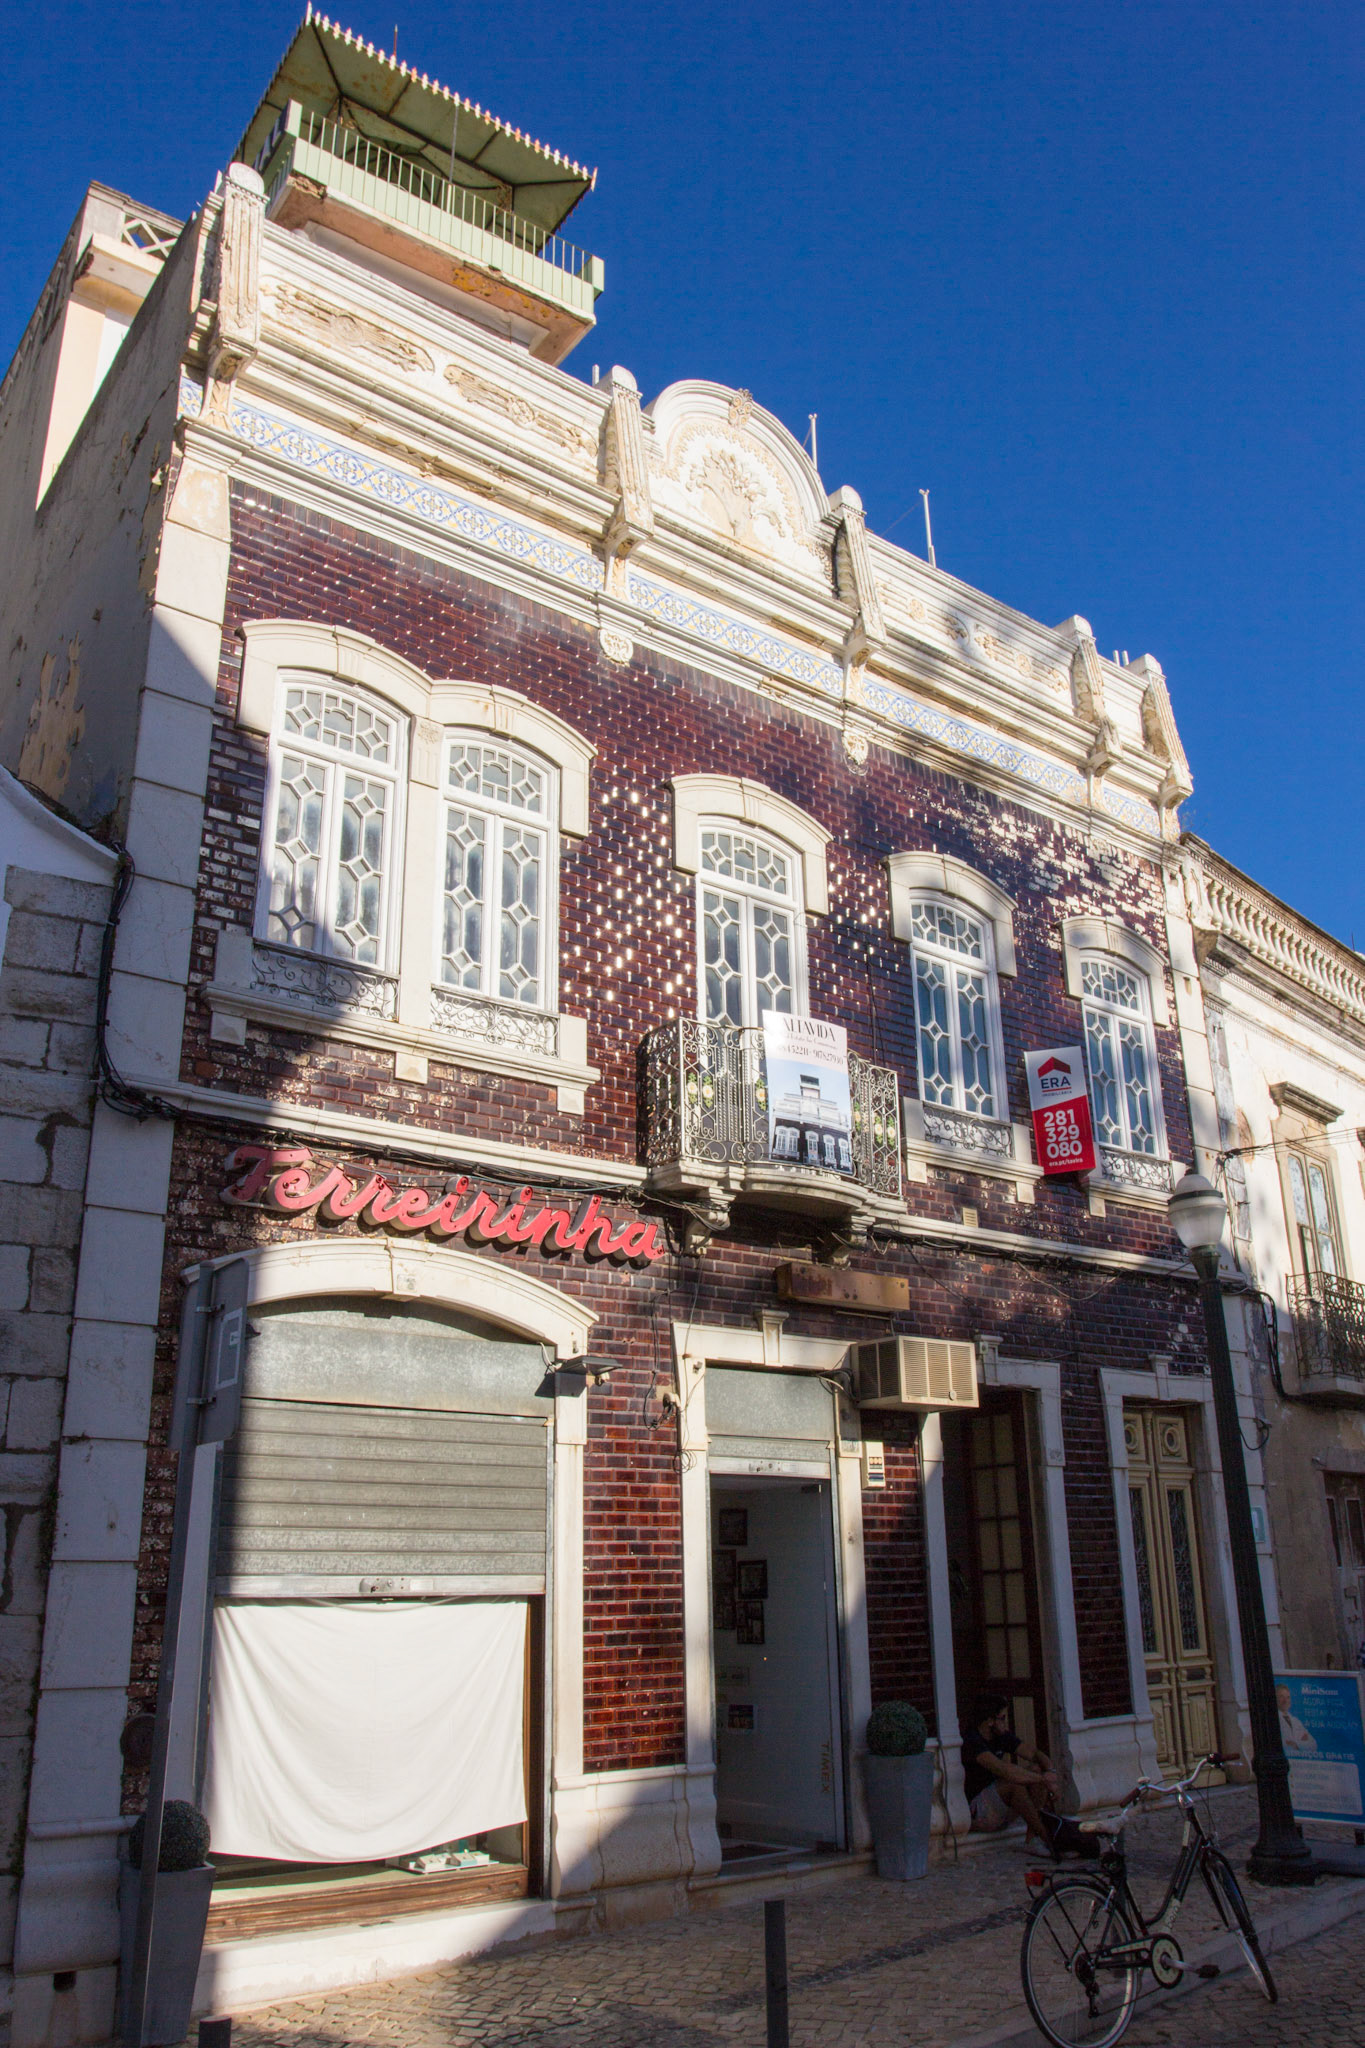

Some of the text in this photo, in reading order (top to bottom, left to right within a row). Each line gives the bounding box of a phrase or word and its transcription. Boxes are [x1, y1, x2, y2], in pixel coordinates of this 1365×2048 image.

[1040, 1076, 1071, 1089] ERA
[1043, 1109, 1075, 1128] 281
[1045, 1124, 1080, 1143] 329
[1046, 1140, 1083, 1159] 080
[219, 1145, 667, 1260] Terreirinha
